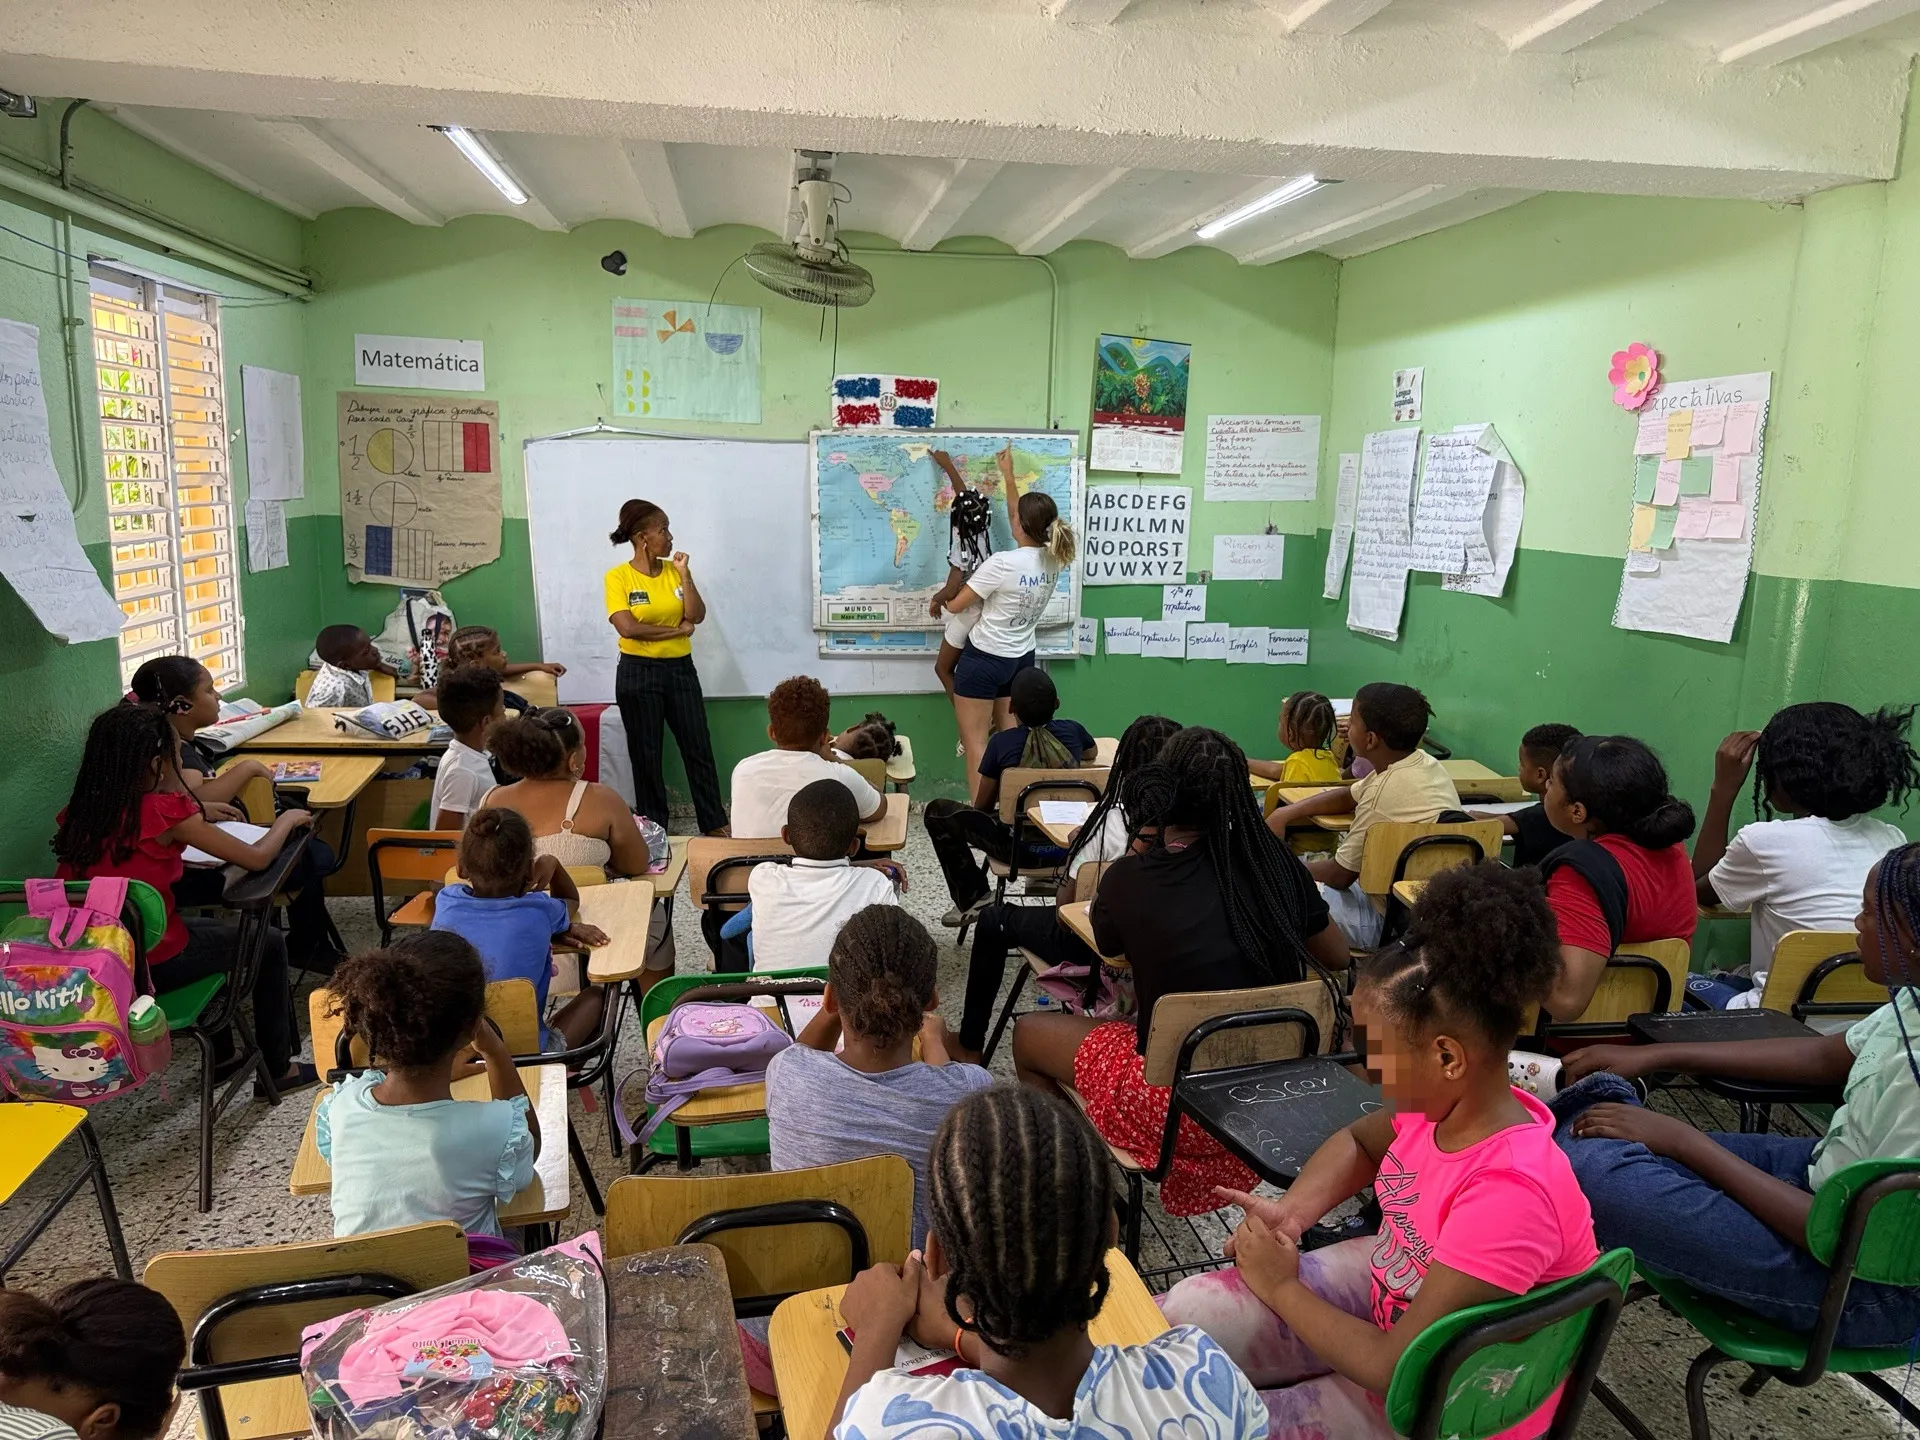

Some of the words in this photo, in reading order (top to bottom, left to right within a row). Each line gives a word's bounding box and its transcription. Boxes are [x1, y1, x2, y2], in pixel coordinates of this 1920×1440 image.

[362, 350, 479, 373] Matemática
[1188, 632, 1225, 645] Sociales
[35, 982, 86, 1009] Kitty
[901, 1351, 939, 1368] APRENDER
